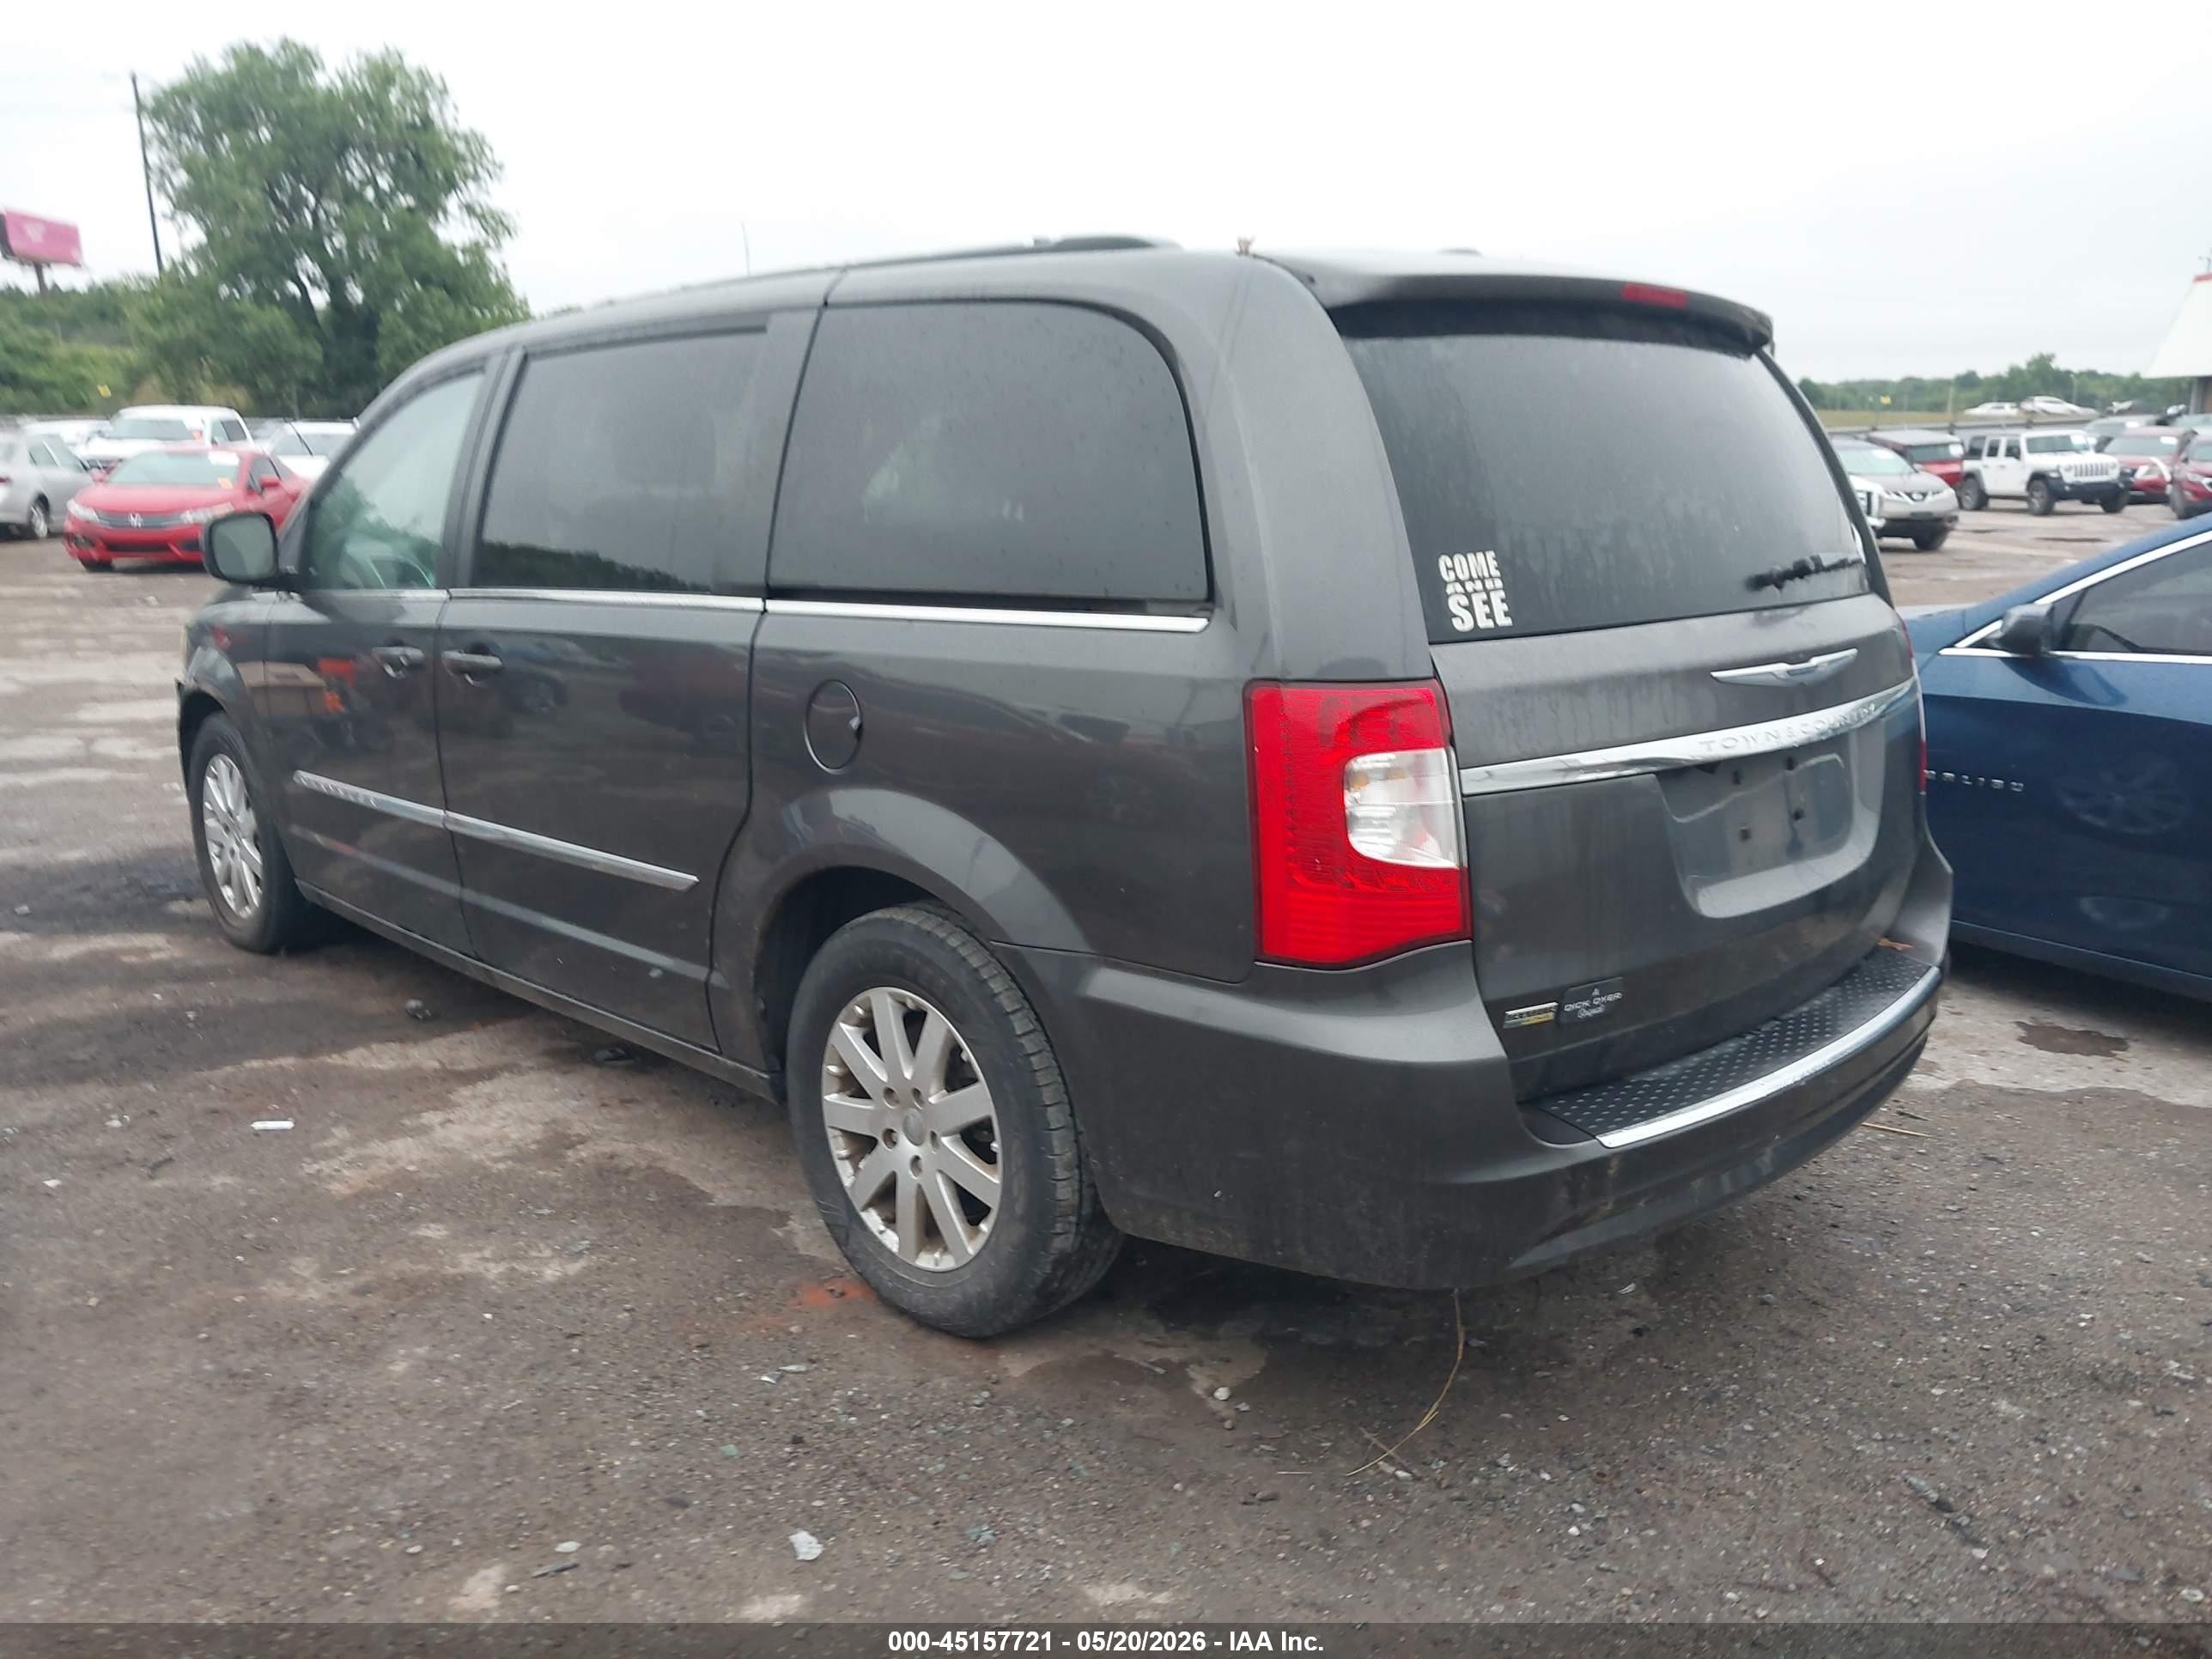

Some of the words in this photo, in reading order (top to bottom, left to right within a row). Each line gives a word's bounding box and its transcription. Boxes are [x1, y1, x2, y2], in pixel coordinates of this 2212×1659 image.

[1437, 550, 1501, 582] COME
[1446, 578, 1504, 594] AND
[1448, 589, 1513, 633] SEE
[1698, 726, 1780, 752] TOWN
